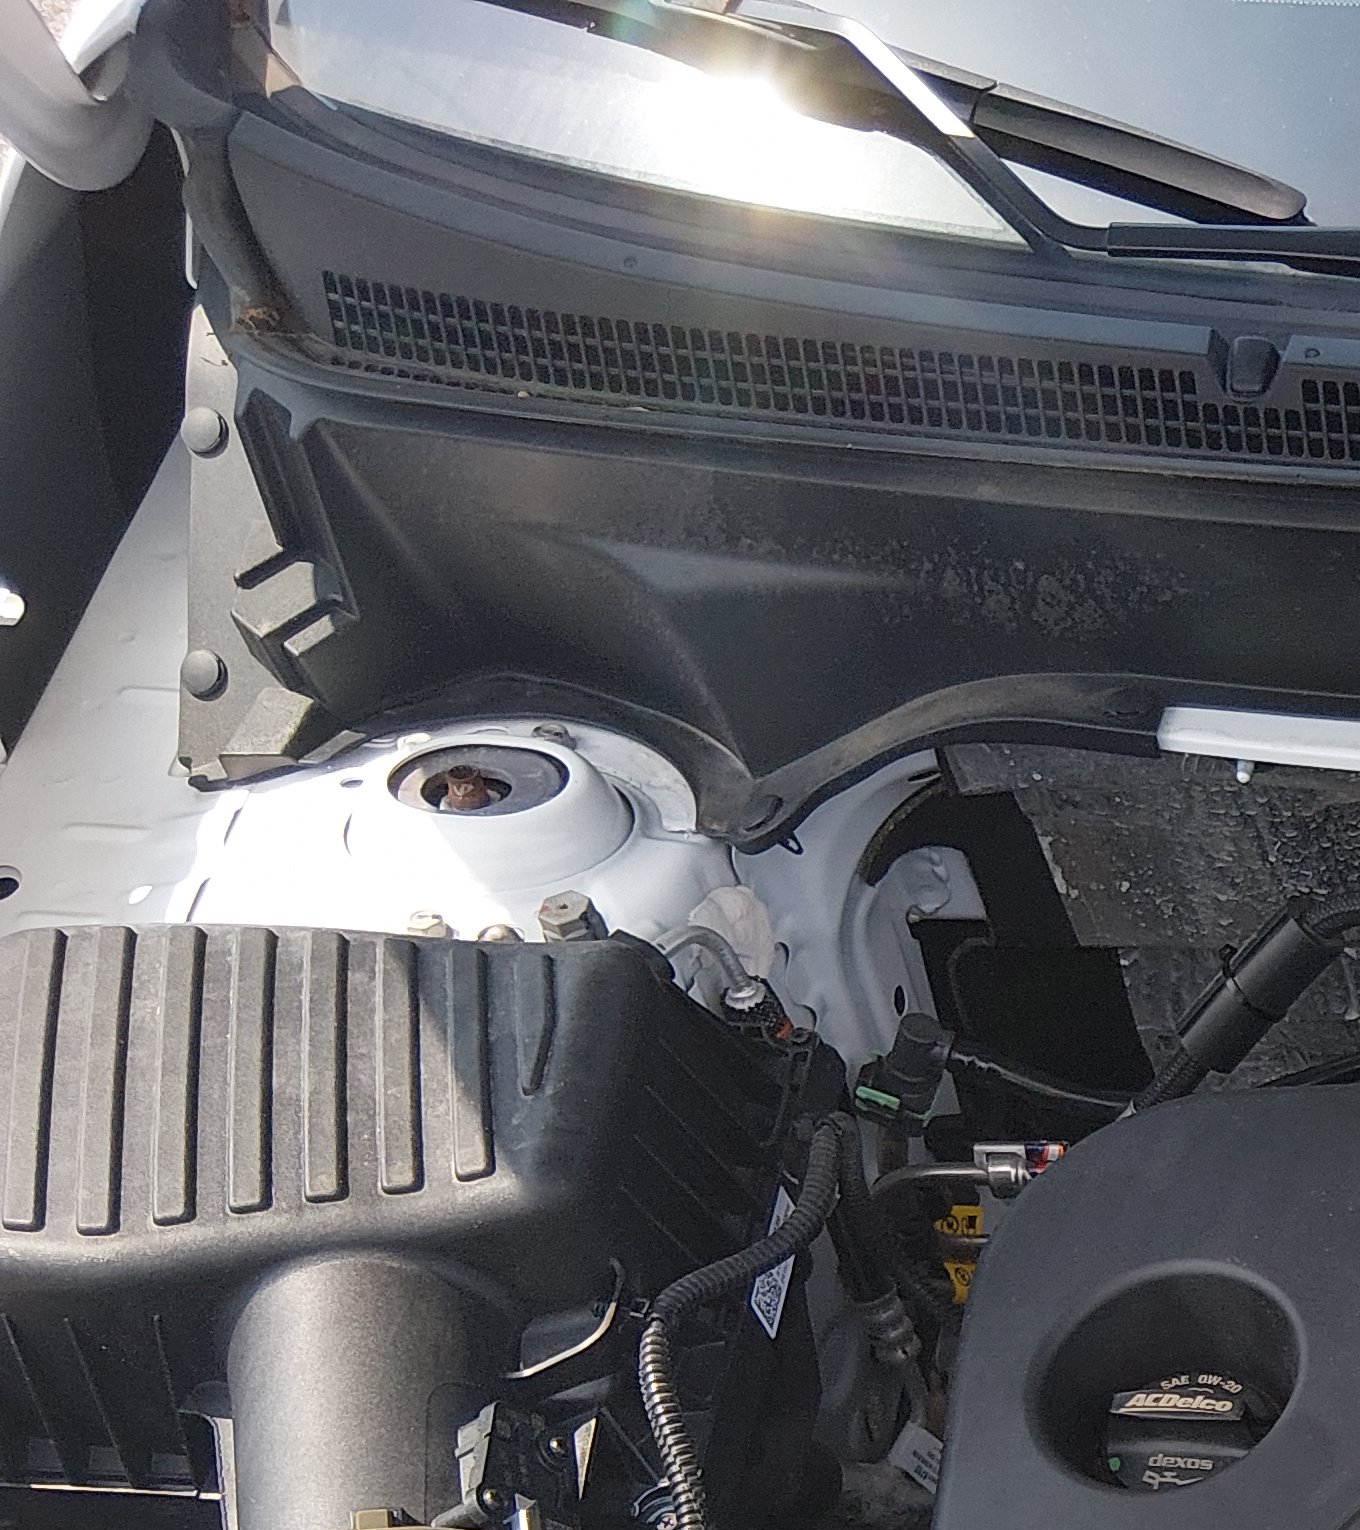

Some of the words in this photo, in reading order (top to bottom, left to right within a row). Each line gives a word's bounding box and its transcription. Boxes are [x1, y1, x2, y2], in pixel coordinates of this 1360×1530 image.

[1161, 1375, 1190, 1390] SAE
[1198, 1374, 1243, 1394] 0W-20
[1124, 1393, 1233, 1412] ACDelco
[1148, 1454, 1213, 1470] dexos
